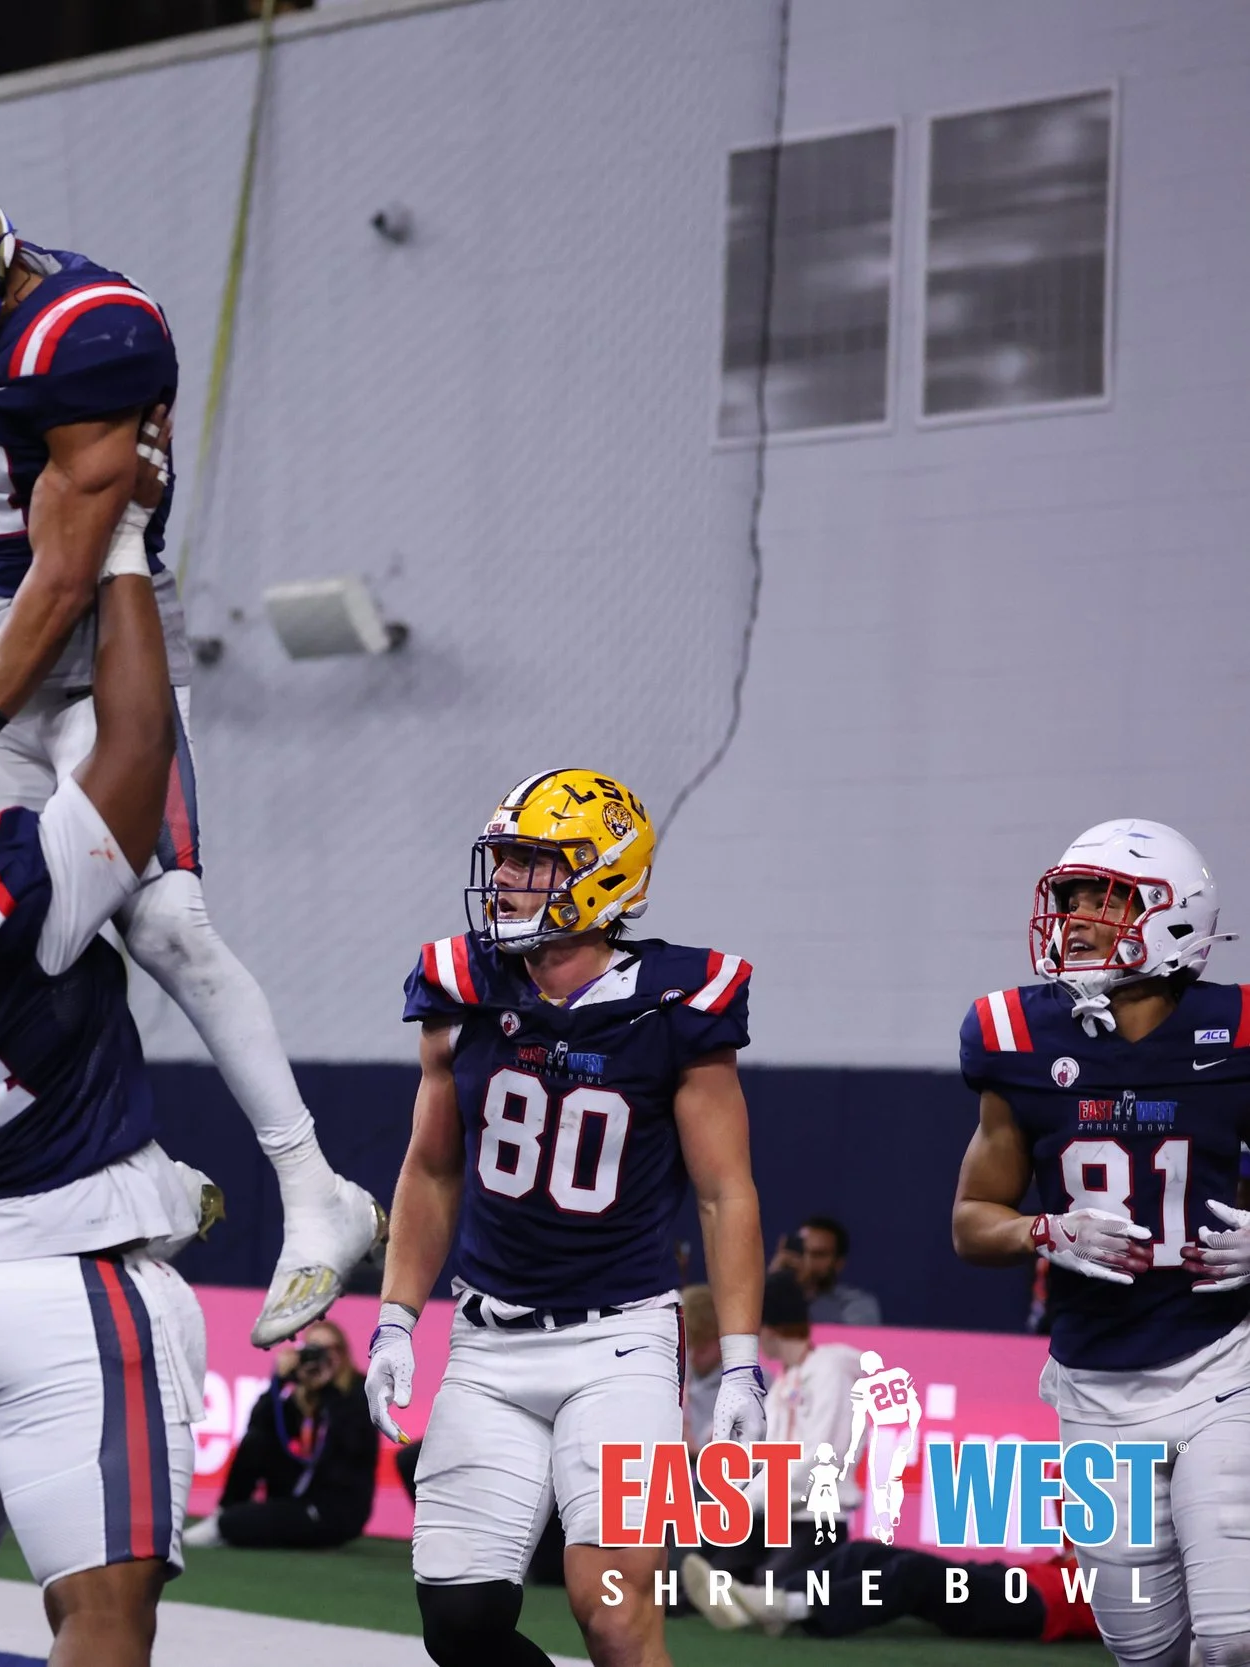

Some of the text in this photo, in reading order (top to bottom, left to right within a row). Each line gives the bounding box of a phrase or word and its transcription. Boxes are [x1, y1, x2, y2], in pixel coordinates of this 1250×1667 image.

[561, 778, 647, 823] LSU
[487, 823, 507, 834] LSU
[1199, 1030, 1227, 1041] ACC
[567, 1052, 607, 1075] WEST
[568, 1073, 603, 1085] BOWL
[1079, 1100, 1178, 1122] EAST WEST
[1078, 1123, 1128, 1131] SHRINE
[477, 1066, 632, 1215] 80
[1061, 1138, 1196, 1267] 81
